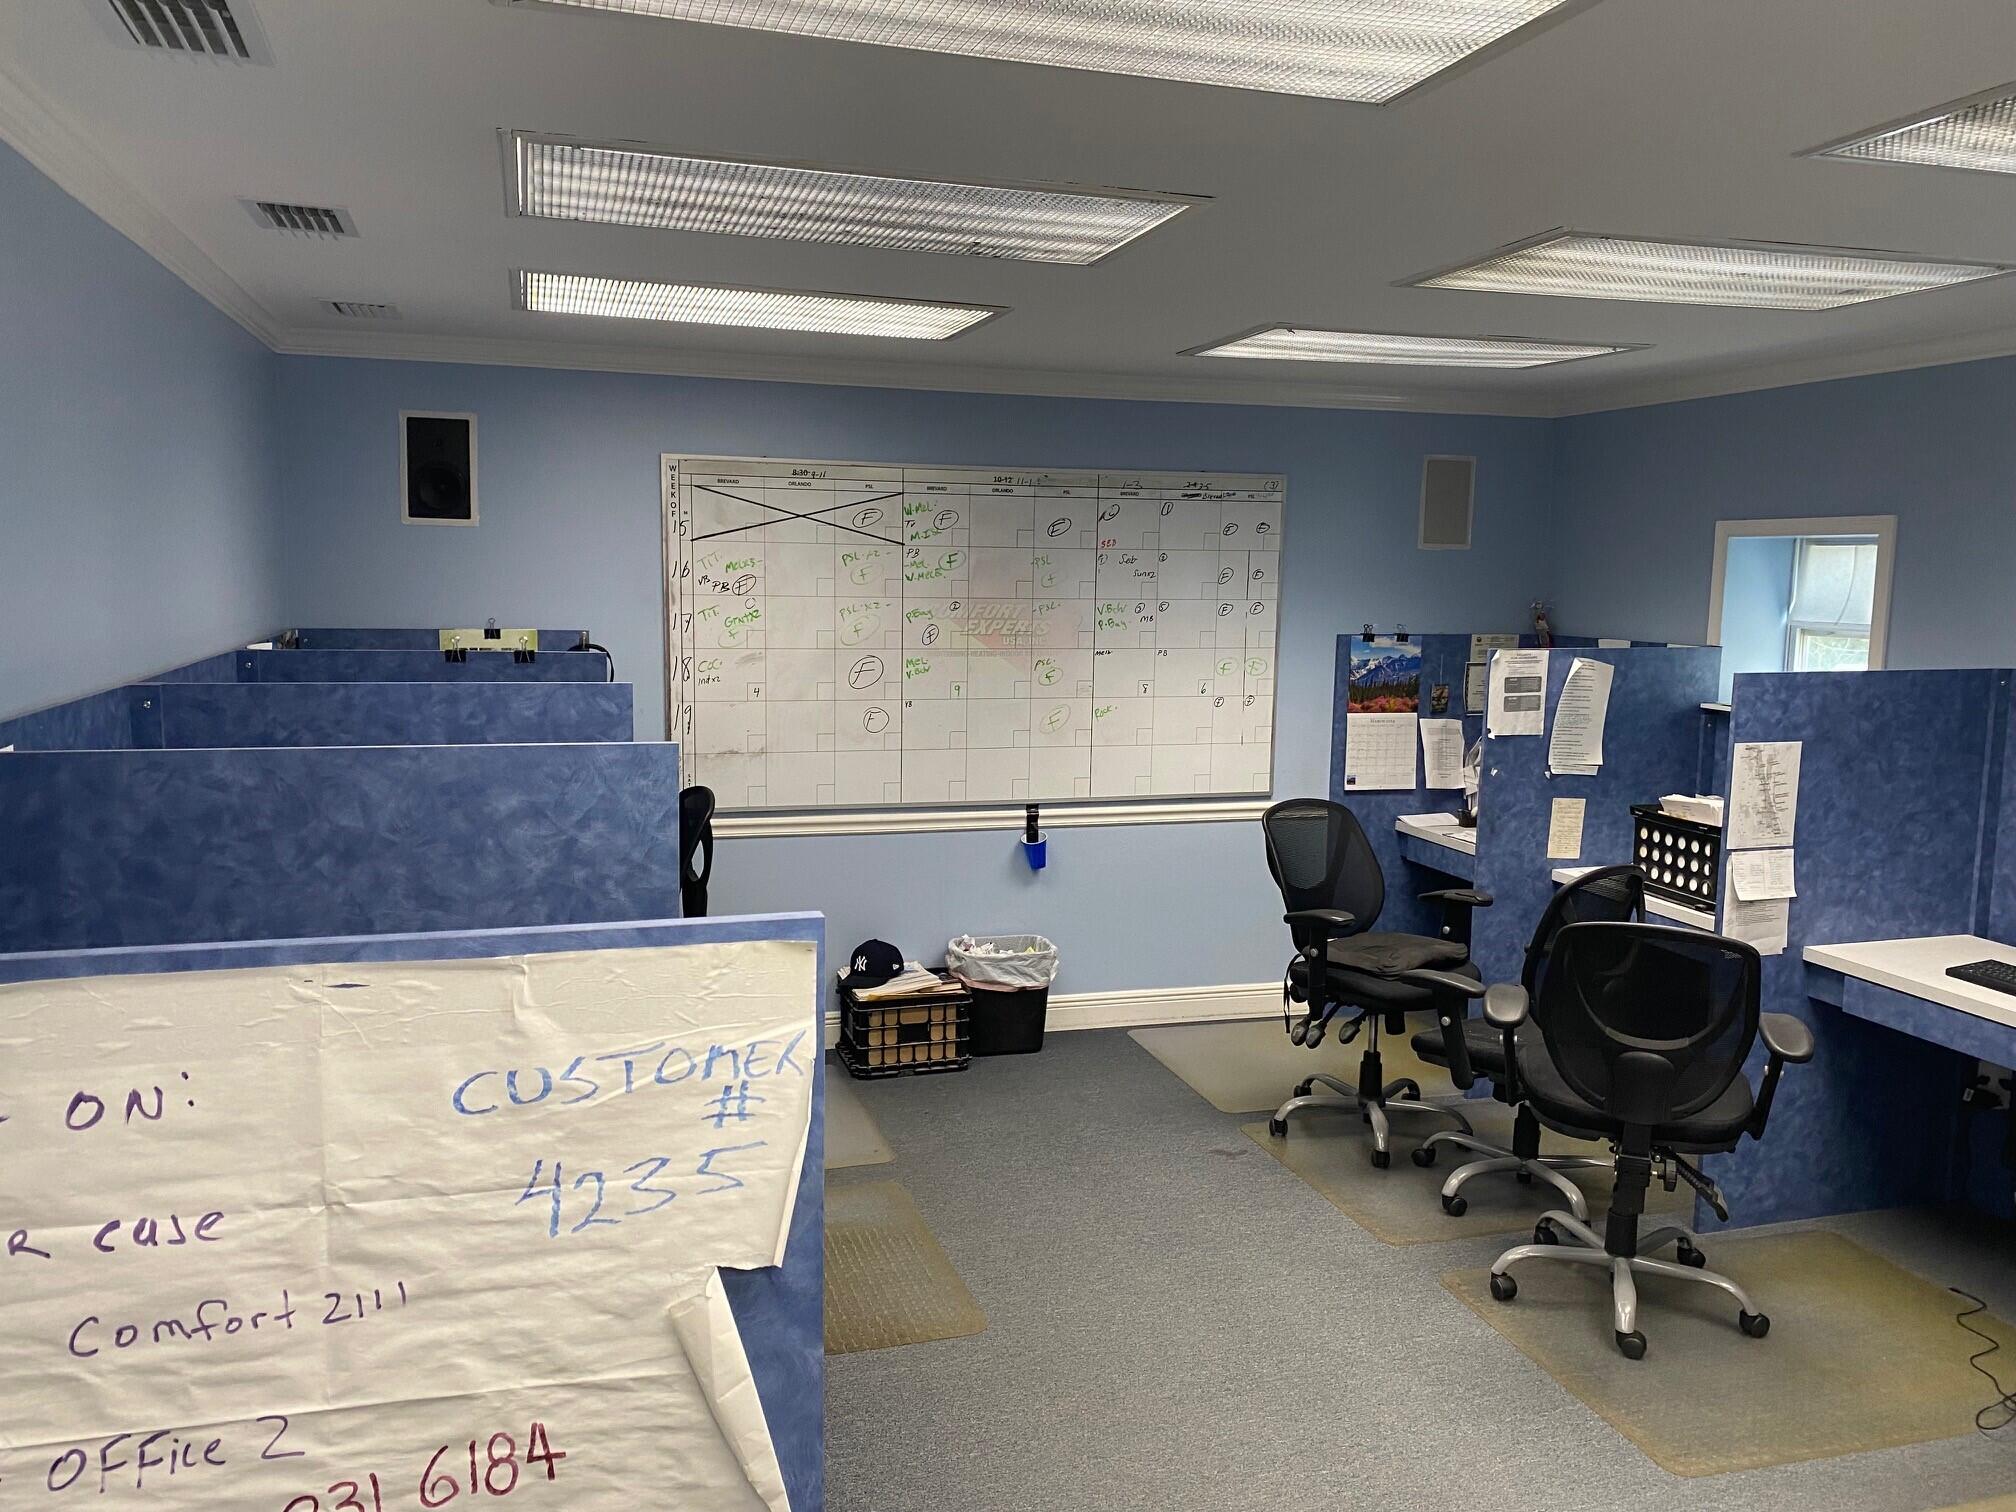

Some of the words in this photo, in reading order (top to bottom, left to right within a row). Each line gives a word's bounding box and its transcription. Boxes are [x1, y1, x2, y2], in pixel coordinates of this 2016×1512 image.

[672, 519, 690, 537] 15
[906, 548, 920, 559] PB
[671, 560, 690, 578] 16
[672, 656, 692, 682] 18
[753, 687, 760, 698] 4
[954, 685, 961, 697] 9
[1200, 682, 1207, 694] 6
[673, 704, 692, 735] 19
[854, 955, 868, 972] NY
[452, 1029, 807, 1117] CUSTOMER
[700, 1079, 767, 1129] #
[514, 1140, 769, 1239] 4235
[69, 1289, 297, 1358] Comfort
[255, 1414, 306, 1461] 2
[418, 1422, 568, 1509] 6184
